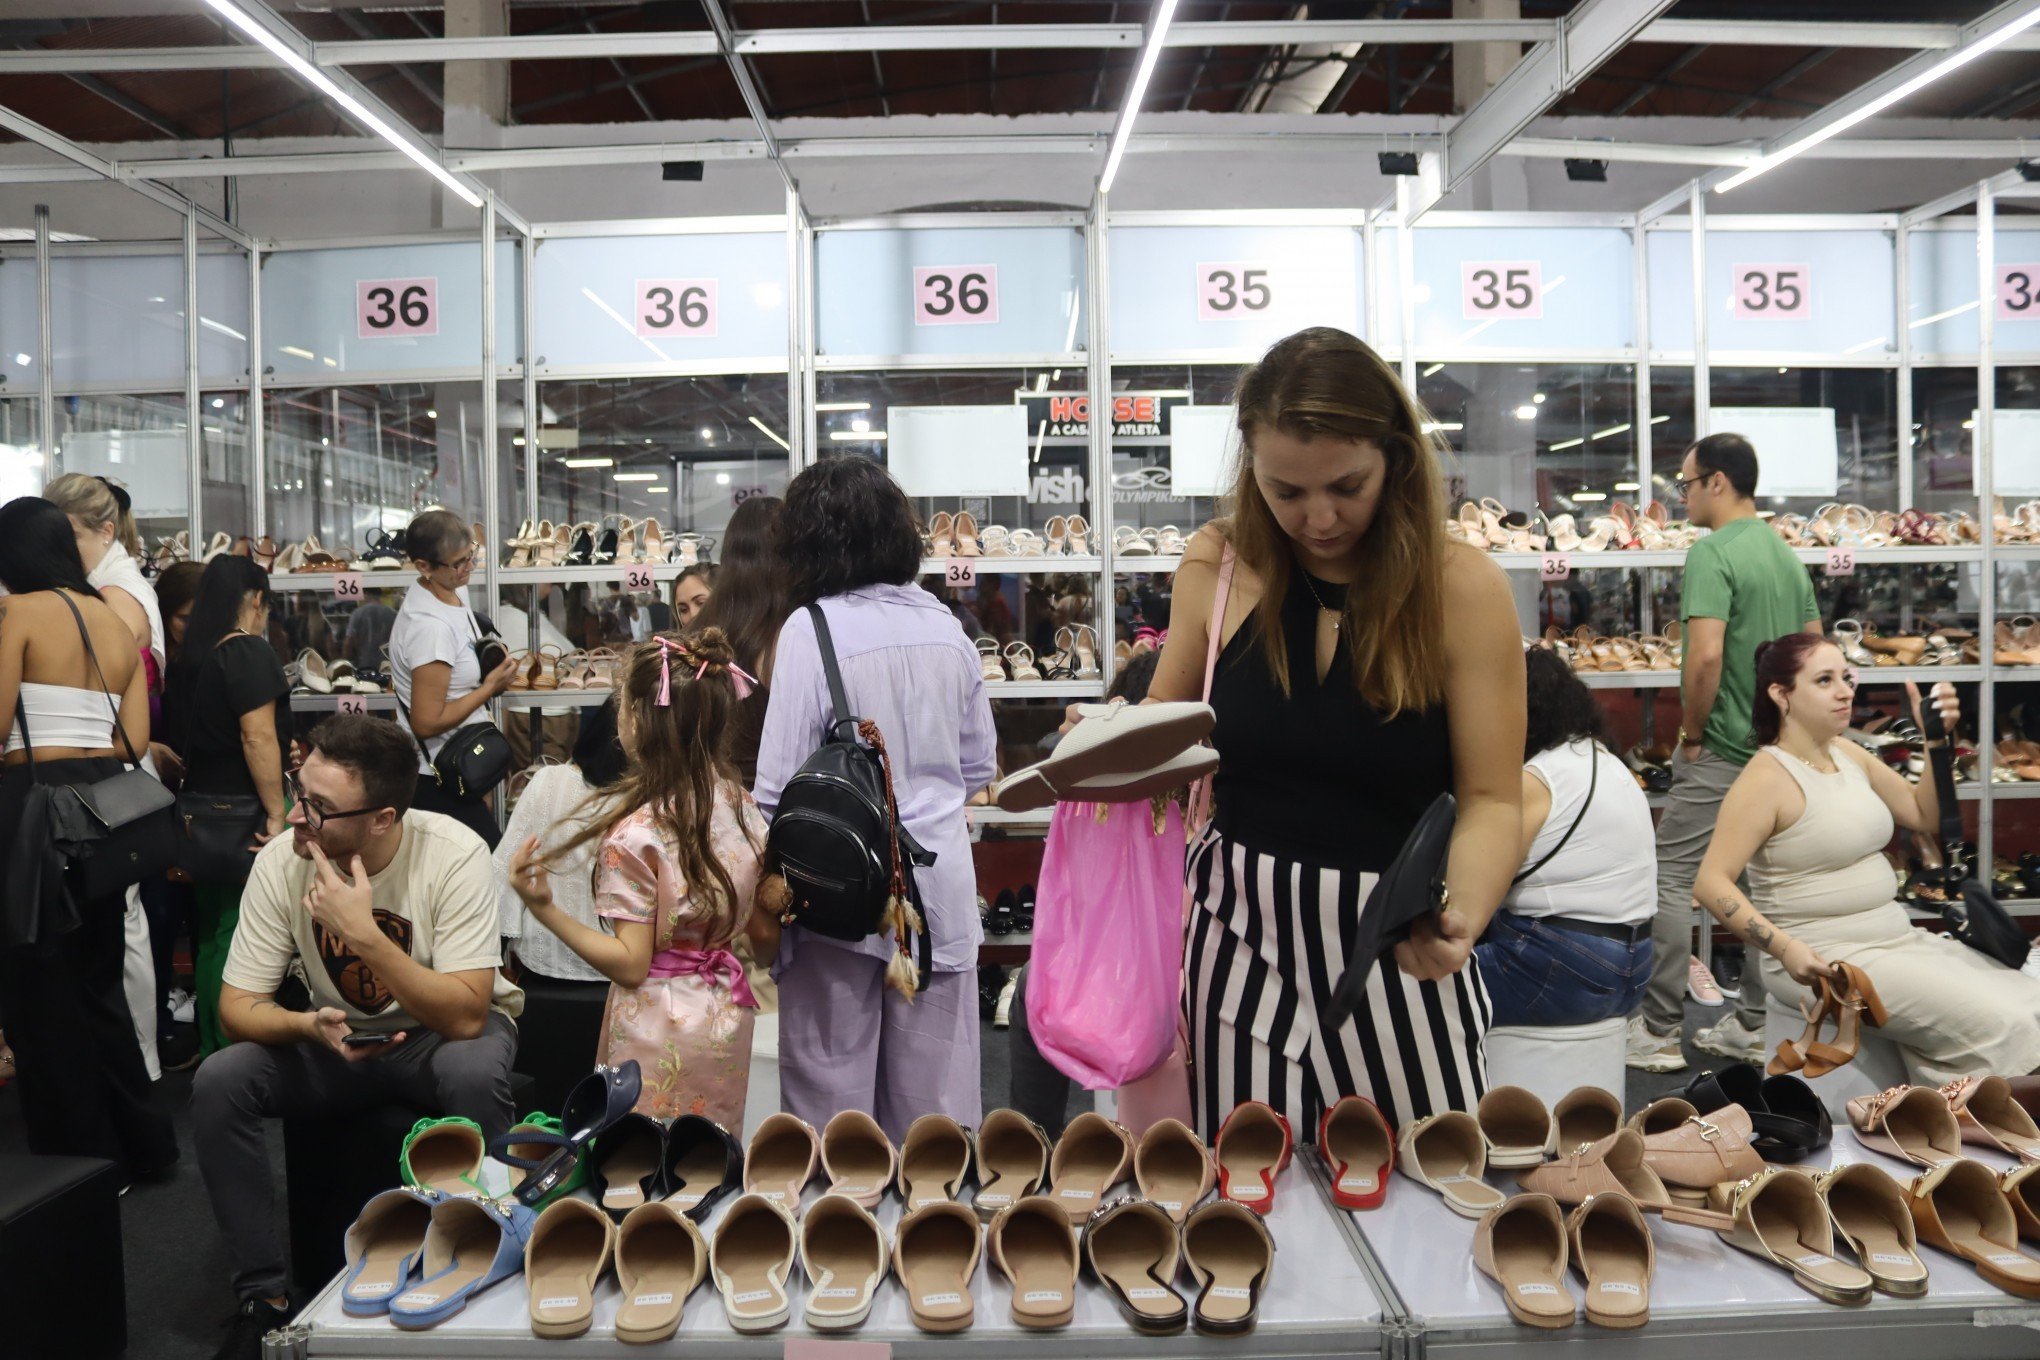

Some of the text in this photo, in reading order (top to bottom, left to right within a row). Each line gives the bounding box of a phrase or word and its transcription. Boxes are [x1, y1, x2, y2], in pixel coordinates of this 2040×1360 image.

[924, 273, 989, 315] 36
[1207, 270, 1272, 310] 35
[1472, 270, 1532, 309] 35
[1742, 271, 1801, 310] 35
[2006, 272, 2040, 310] 3
[366, 287, 430, 329] 36
[645, 287, 708, 328] 36
[1050, 396, 1154, 422] HOSE
[1051, 424, 1061, 435] A
[1062, 424, 1089, 435] CAS
[1117, 424, 1160, 435] ATLETA
[949, 565, 971, 581] 36
[1545, 559, 1566, 575] 35
[1831, 554, 1852, 570] 35
[338, 579, 359, 595] 36
[628, 571, 650, 587] 36
